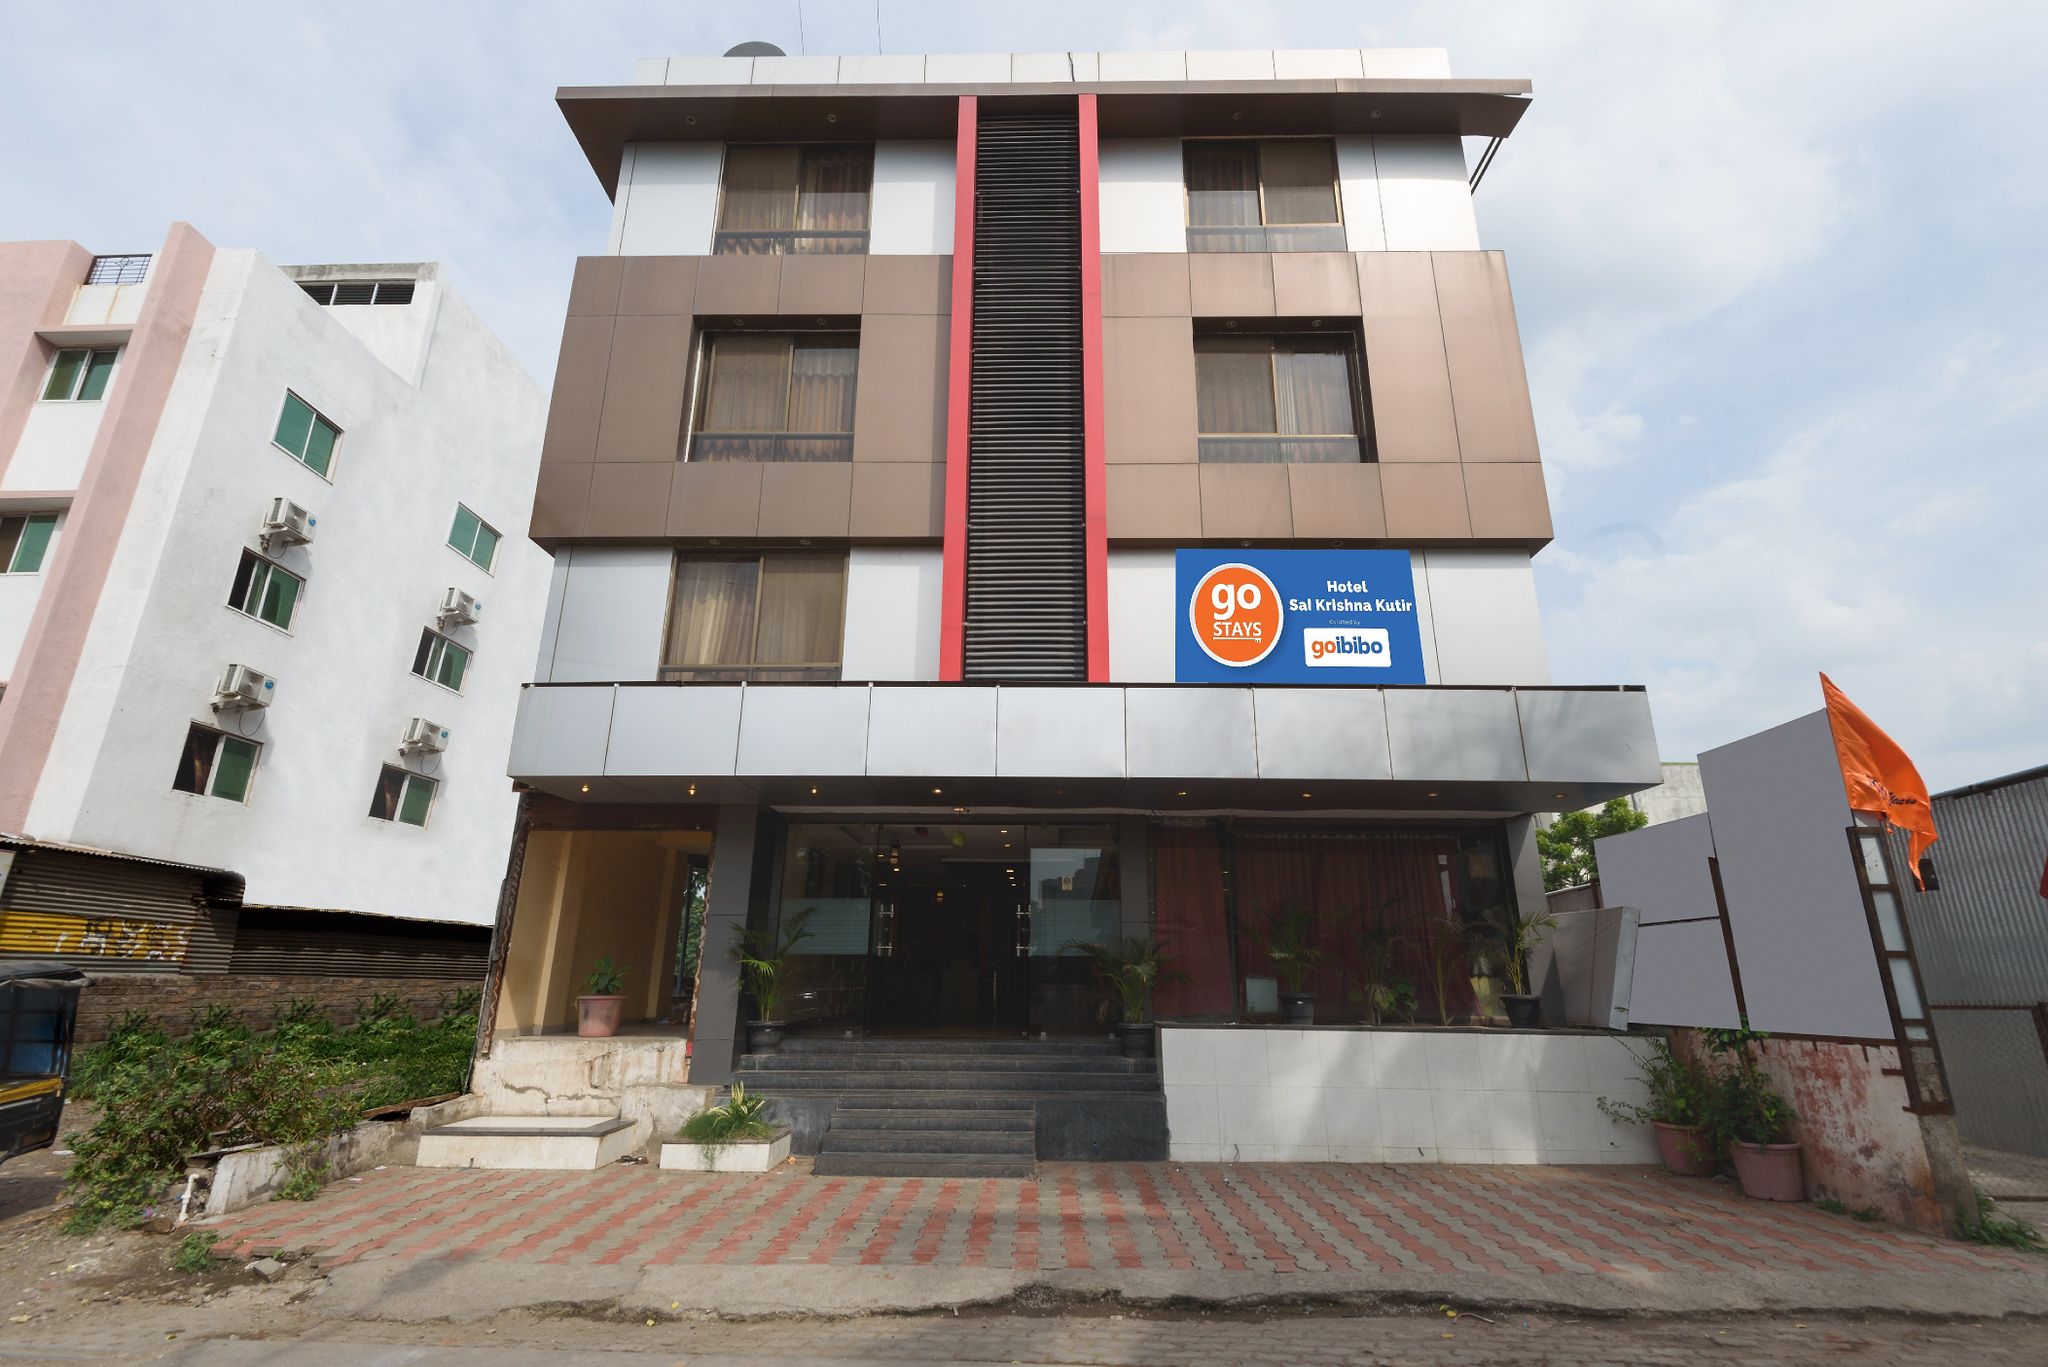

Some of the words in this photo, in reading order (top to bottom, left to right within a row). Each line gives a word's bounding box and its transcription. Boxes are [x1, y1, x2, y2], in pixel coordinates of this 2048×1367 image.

[1326, 580, 1368, 593] Hotel
[1211, 583, 1262, 620] go
[1375, 598, 1413, 612] Kutir
[1213, 621, 1262, 637] STAYS
[1311, 635, 1383, 659] goibibo
